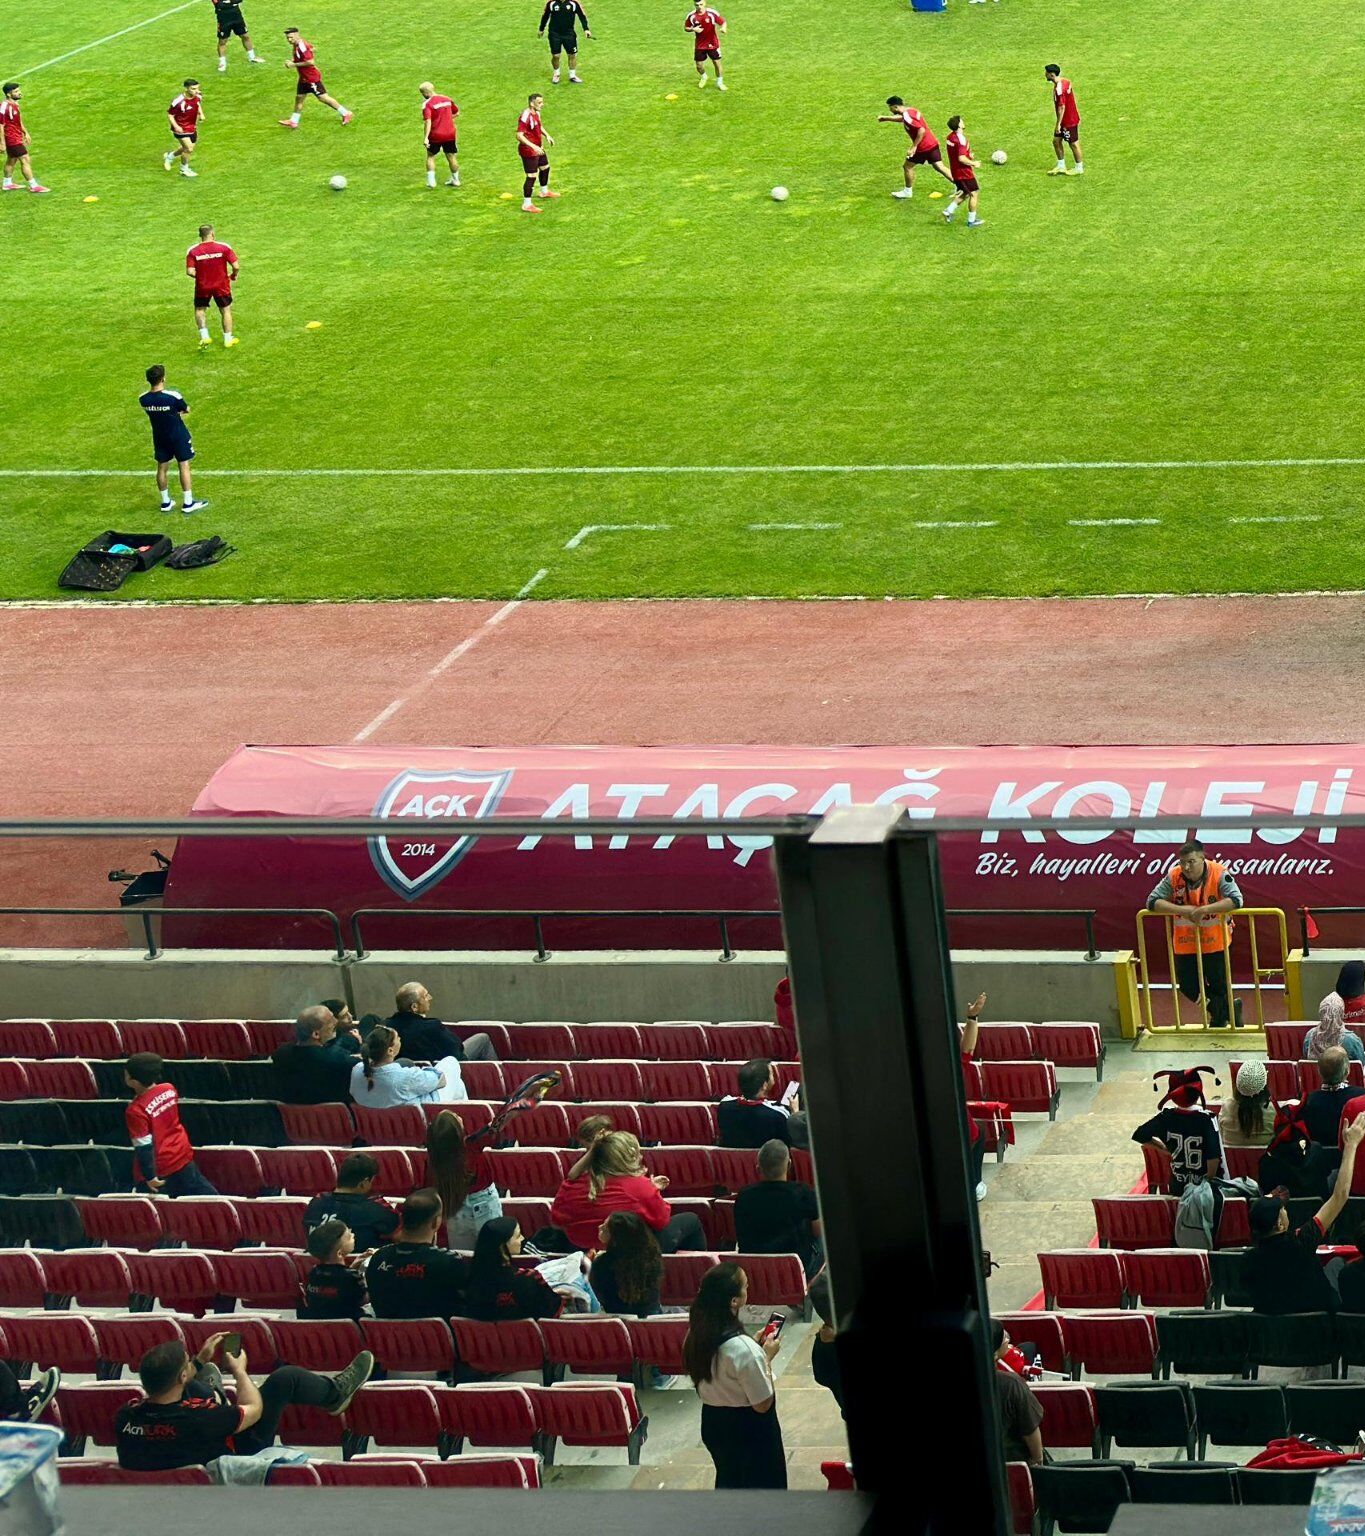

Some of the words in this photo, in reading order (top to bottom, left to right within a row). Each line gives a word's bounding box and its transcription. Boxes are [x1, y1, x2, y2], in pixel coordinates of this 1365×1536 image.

[980, 768, 1354, 845] KOLEJİ
[402, 842, 435, 857] 2014
[975, 852, 1019, 877] Biz,
[1029, 852, 1141, 882] hayalleri
